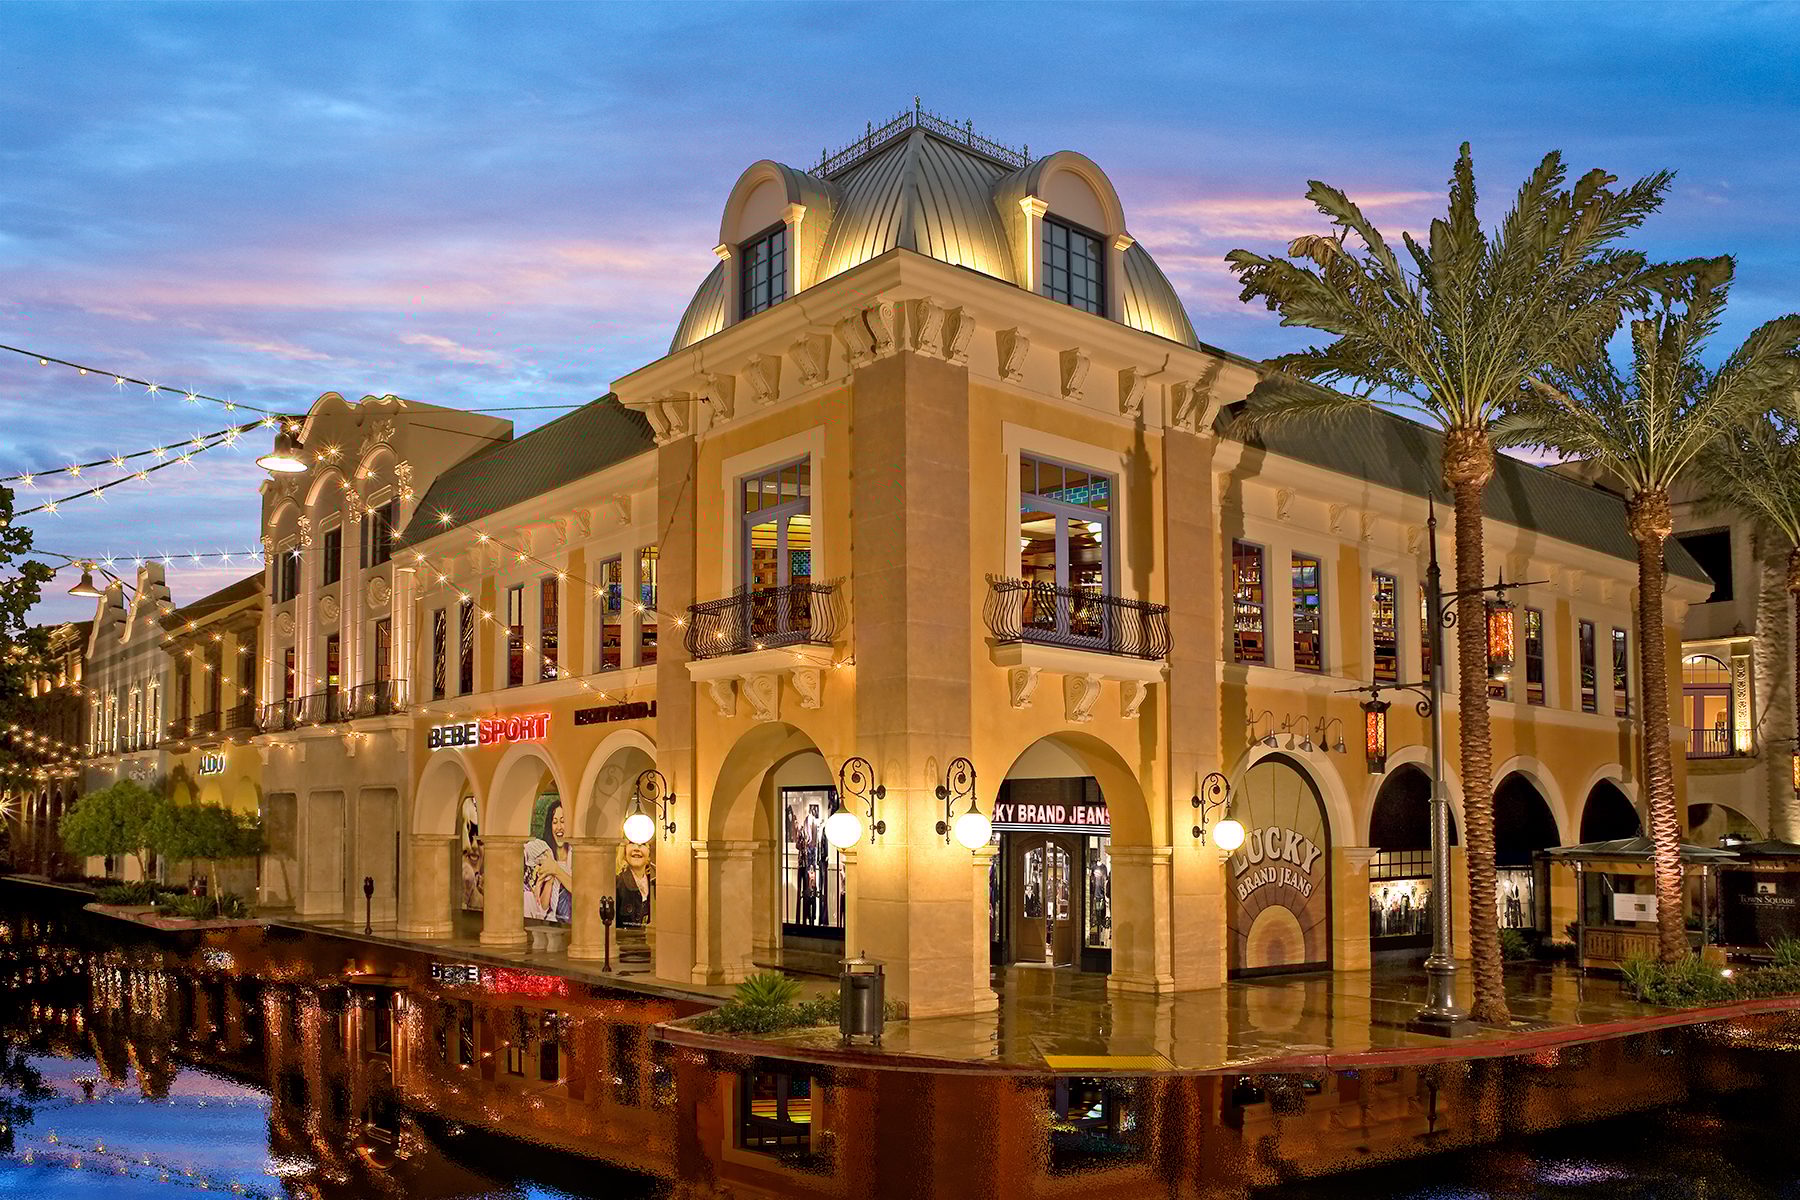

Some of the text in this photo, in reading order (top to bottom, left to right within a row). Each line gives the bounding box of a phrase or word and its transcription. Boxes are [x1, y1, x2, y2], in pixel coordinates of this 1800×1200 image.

[428, 722, 478, 749] BEBE
[480, 713, 551, 745] SPORT
[198, 753, 226, 776] ALDO
[1018, 804, 1066, 824] BRAND
[1232, 826, 1322, 879] LUCKY
[1236, 866, 1313, 901] BRAND JEANS
